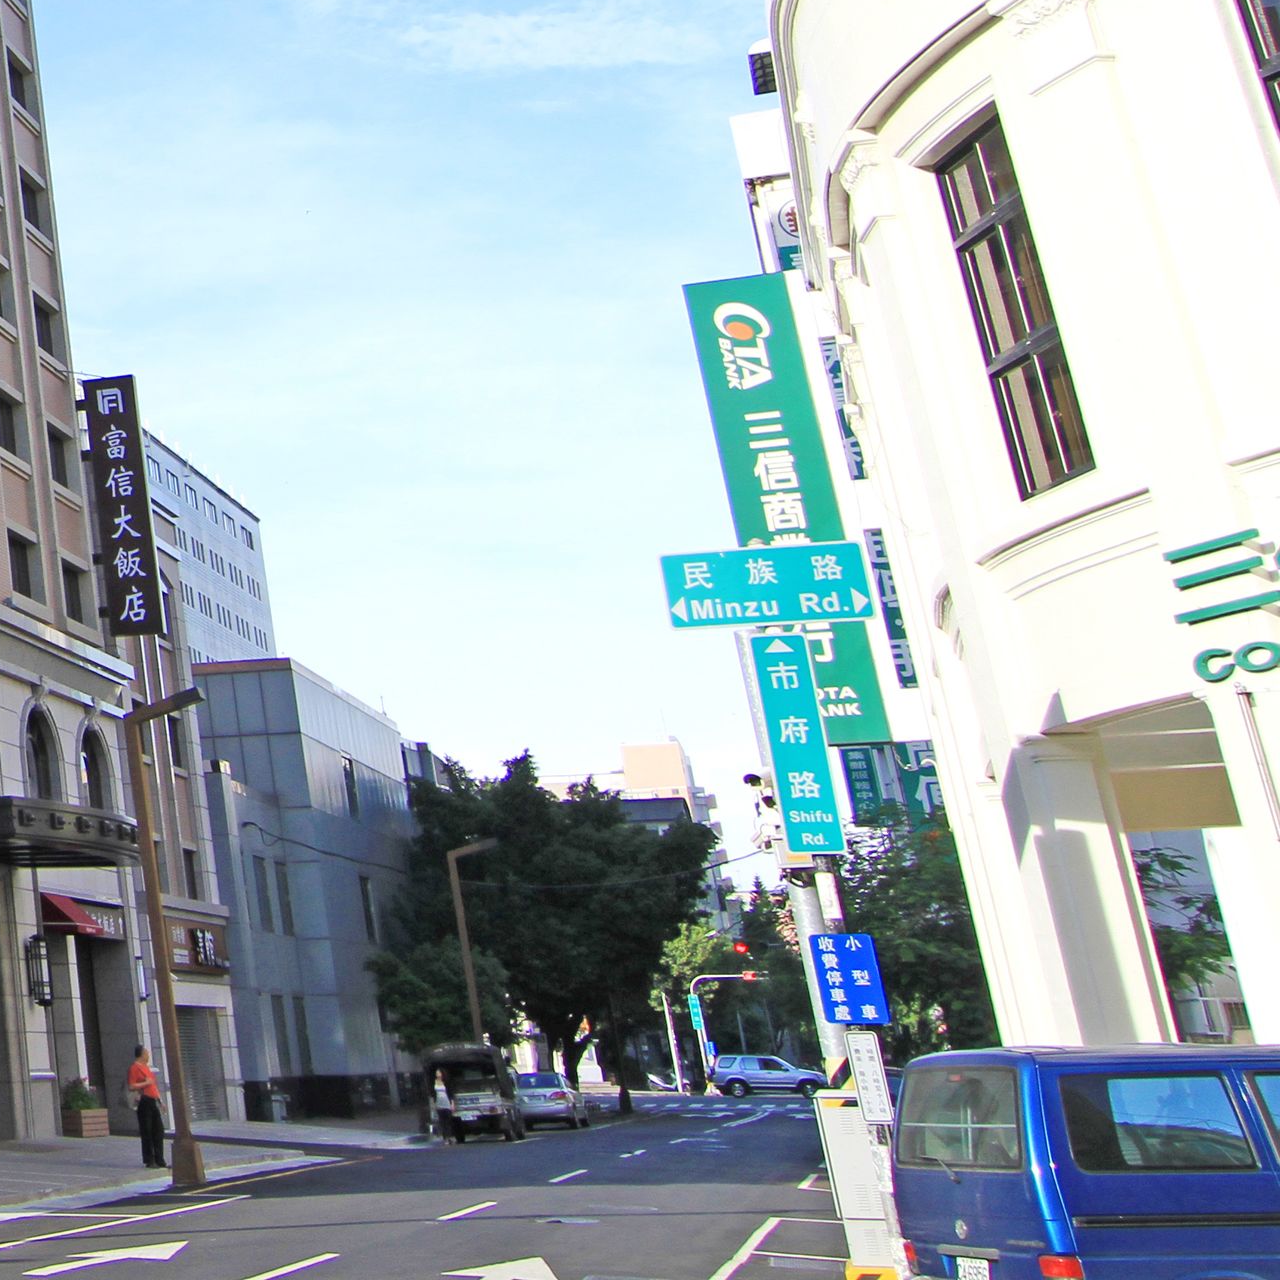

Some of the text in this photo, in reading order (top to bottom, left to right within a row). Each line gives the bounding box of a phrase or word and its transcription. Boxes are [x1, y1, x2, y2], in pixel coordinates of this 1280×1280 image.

[102, 424, 146, 622] 富信大飯店
[683, 554, 843, 590] 民族路
[690, 592, 849, 620] Minzu Rd.
[767, 662, 821, 799] 市府路
[789, 810, 833, 823] Shifu
[801, 833, 829, 846] Rd.
[818, 936, 852, 1020] 收費停車處
[845, 936, 878, 1020] 小型車
